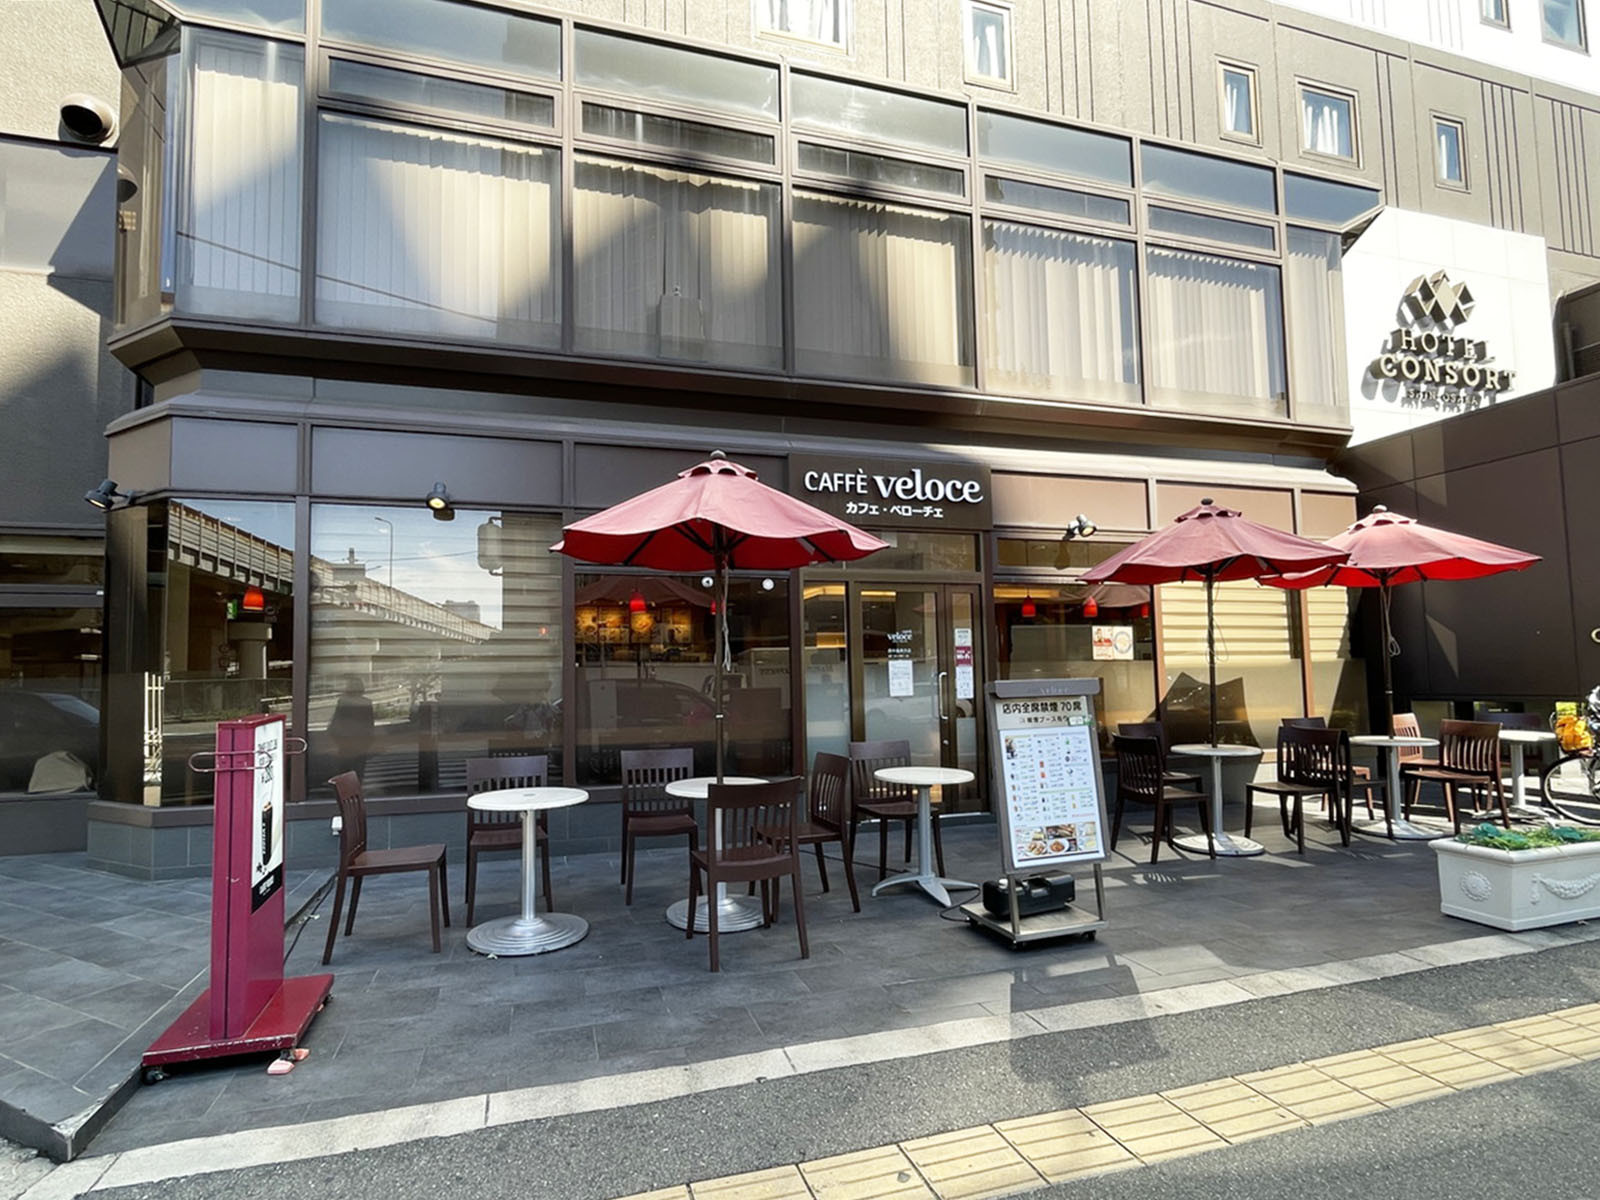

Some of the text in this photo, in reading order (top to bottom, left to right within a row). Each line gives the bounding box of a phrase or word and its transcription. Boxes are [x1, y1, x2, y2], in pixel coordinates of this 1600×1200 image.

[1380, 353, 1516, 391] CONSORT
[804, 468, 984, 503] CAFFÈ veloce
[846, 502, 944, 518] カフェ・ベローチェ
